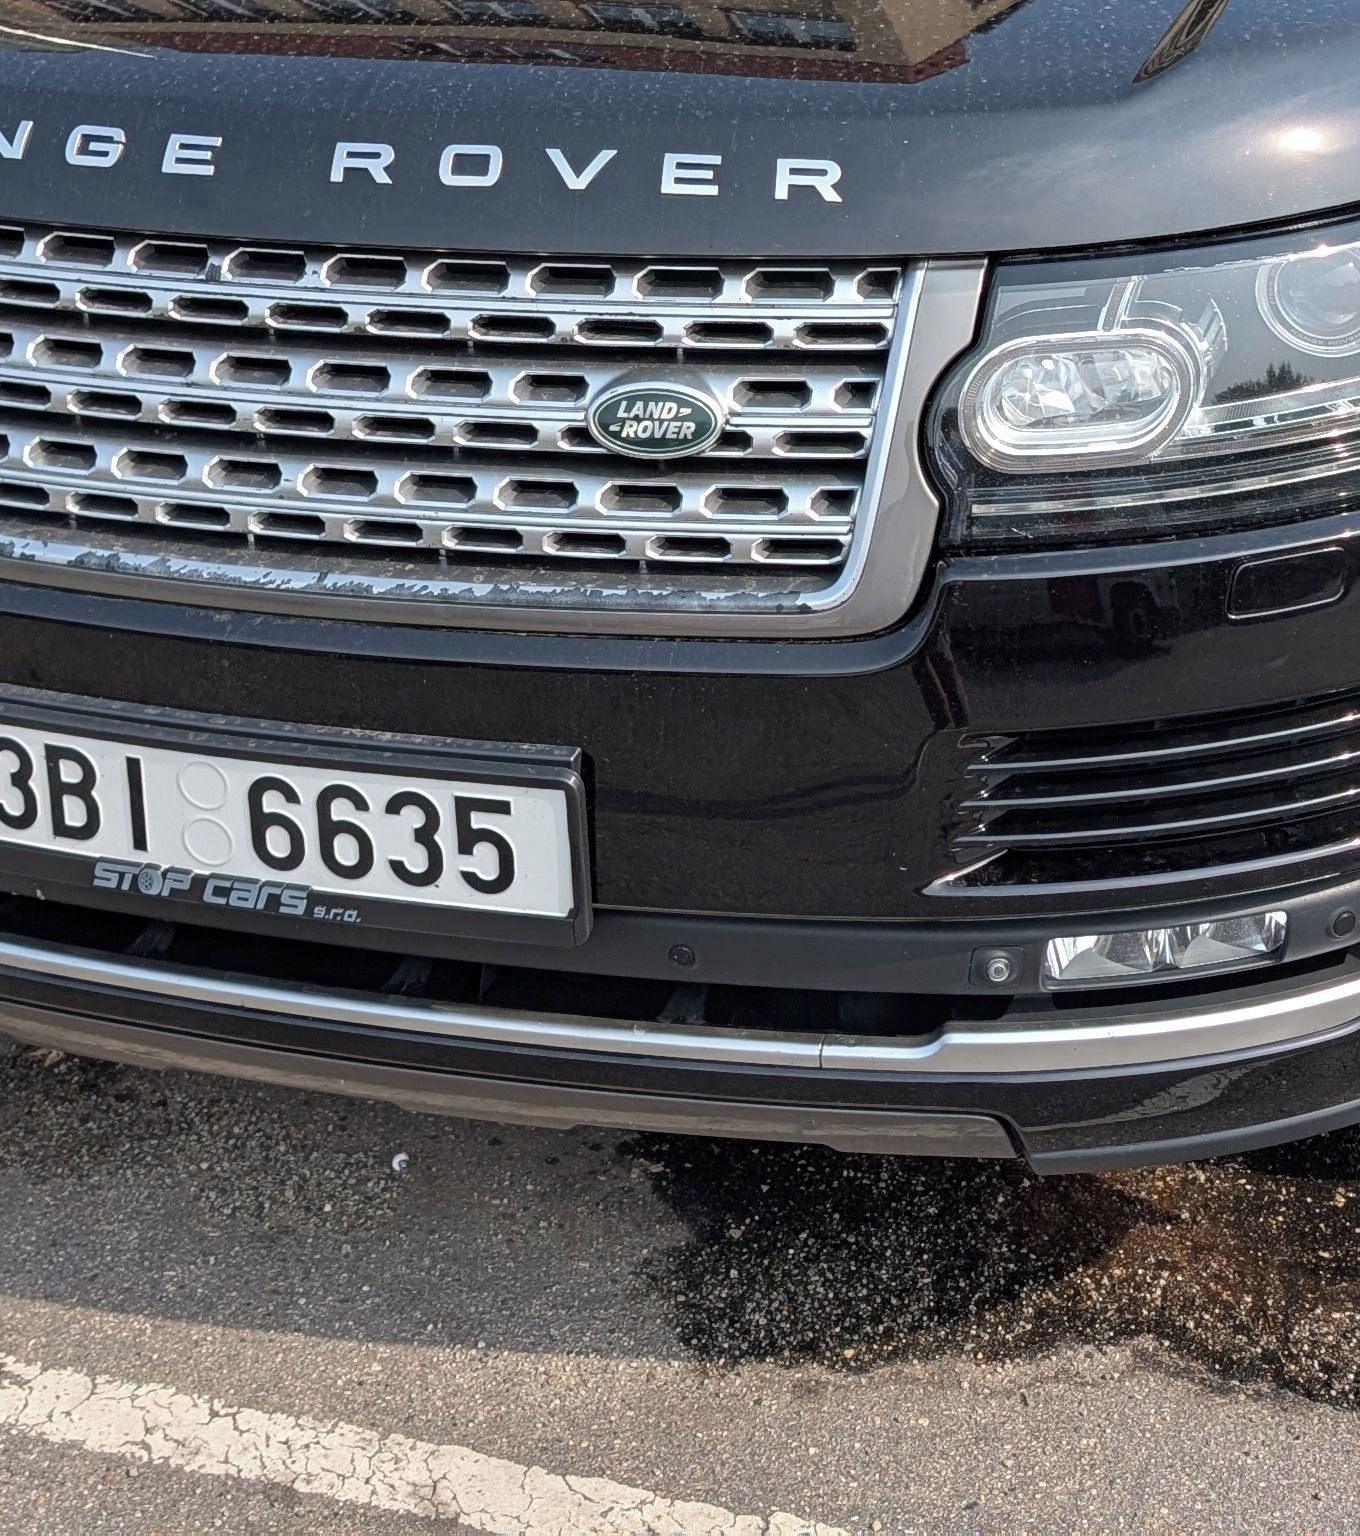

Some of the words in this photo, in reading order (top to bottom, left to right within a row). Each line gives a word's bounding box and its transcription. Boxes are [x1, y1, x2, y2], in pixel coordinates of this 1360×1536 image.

[330, 142, 844, 203] ROVER
[616, 400, 678, 419] LAND
[620, 420, 696, 440] ROVER
[247, 775, 516, 895] 6635
[93, 861, 191, 897] STOP
